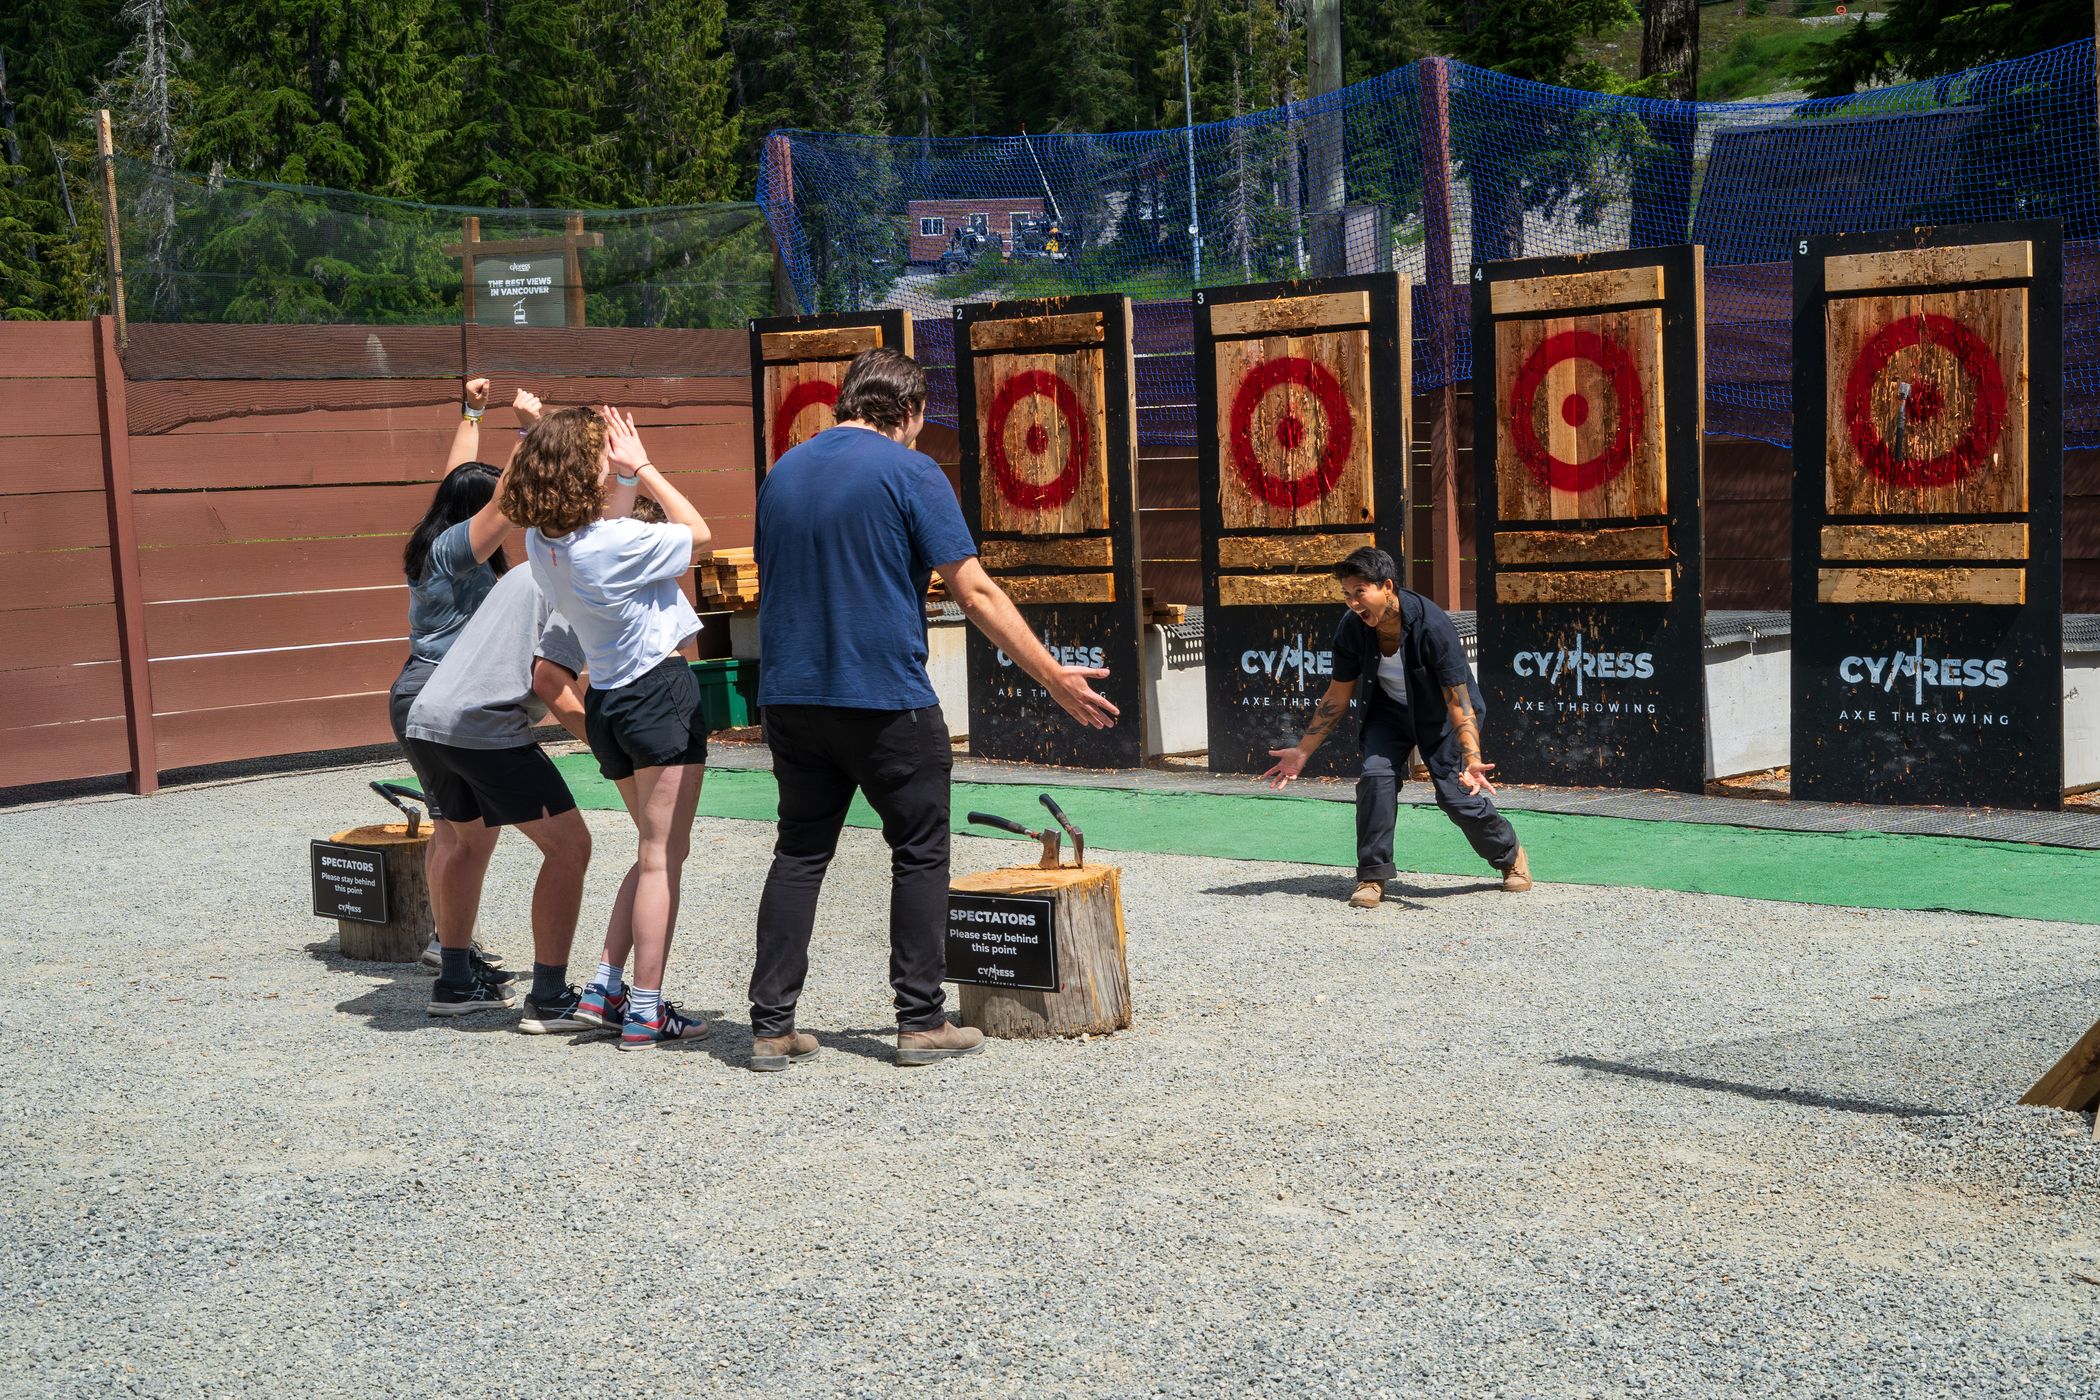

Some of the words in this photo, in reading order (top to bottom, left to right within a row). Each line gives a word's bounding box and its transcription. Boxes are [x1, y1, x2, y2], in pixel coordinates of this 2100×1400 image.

[1799, 240, 1808, 255] 5
[1475, 267, 1483, 281] 4
[488, 279, 504, 288] THE
[505, 278, 525, 287] BEST
[527, 276, 552, 286] VIEWS
[490, 288, 500, 296] IN
[501, 286, 550, 296] VANCOUVER
[1197, 292, 1204, 305] 3
[956, 308, 963, 320] 2
[750, 320, 755, 332] 1
[996, 645, 1105, 668] CESS
[1513, 633, 1654, 696] CYPRESS
[1839, 637, 2009, 705] CYPRESS
[1242, 697, 1270, 706] AXE
[1513, 701, 1545, 711] AXE
[1557, 702, 1656, 714] THROWING
[1839, 710, 1877, 721] AXE
[1892, 711, 2009, 725] THROWING
[321, 856, 374, 873] SPECTATORS
[321, 872, 340, 882] Please
[341, 876, 354, 885] stay
[354, 877, 376, 887] behind
[334, 884, 346, 893] this
[347, 887, 363, 895] point
[949, 909, 1037, 927] SPECTATORS
[949, 928, 981, 940] Please
[982, 932, 1003, 943] stay
[1004, 933, 1039, 945] behind
[971, 943, 990, 953] this
[991, 945, 1018, 956] point
